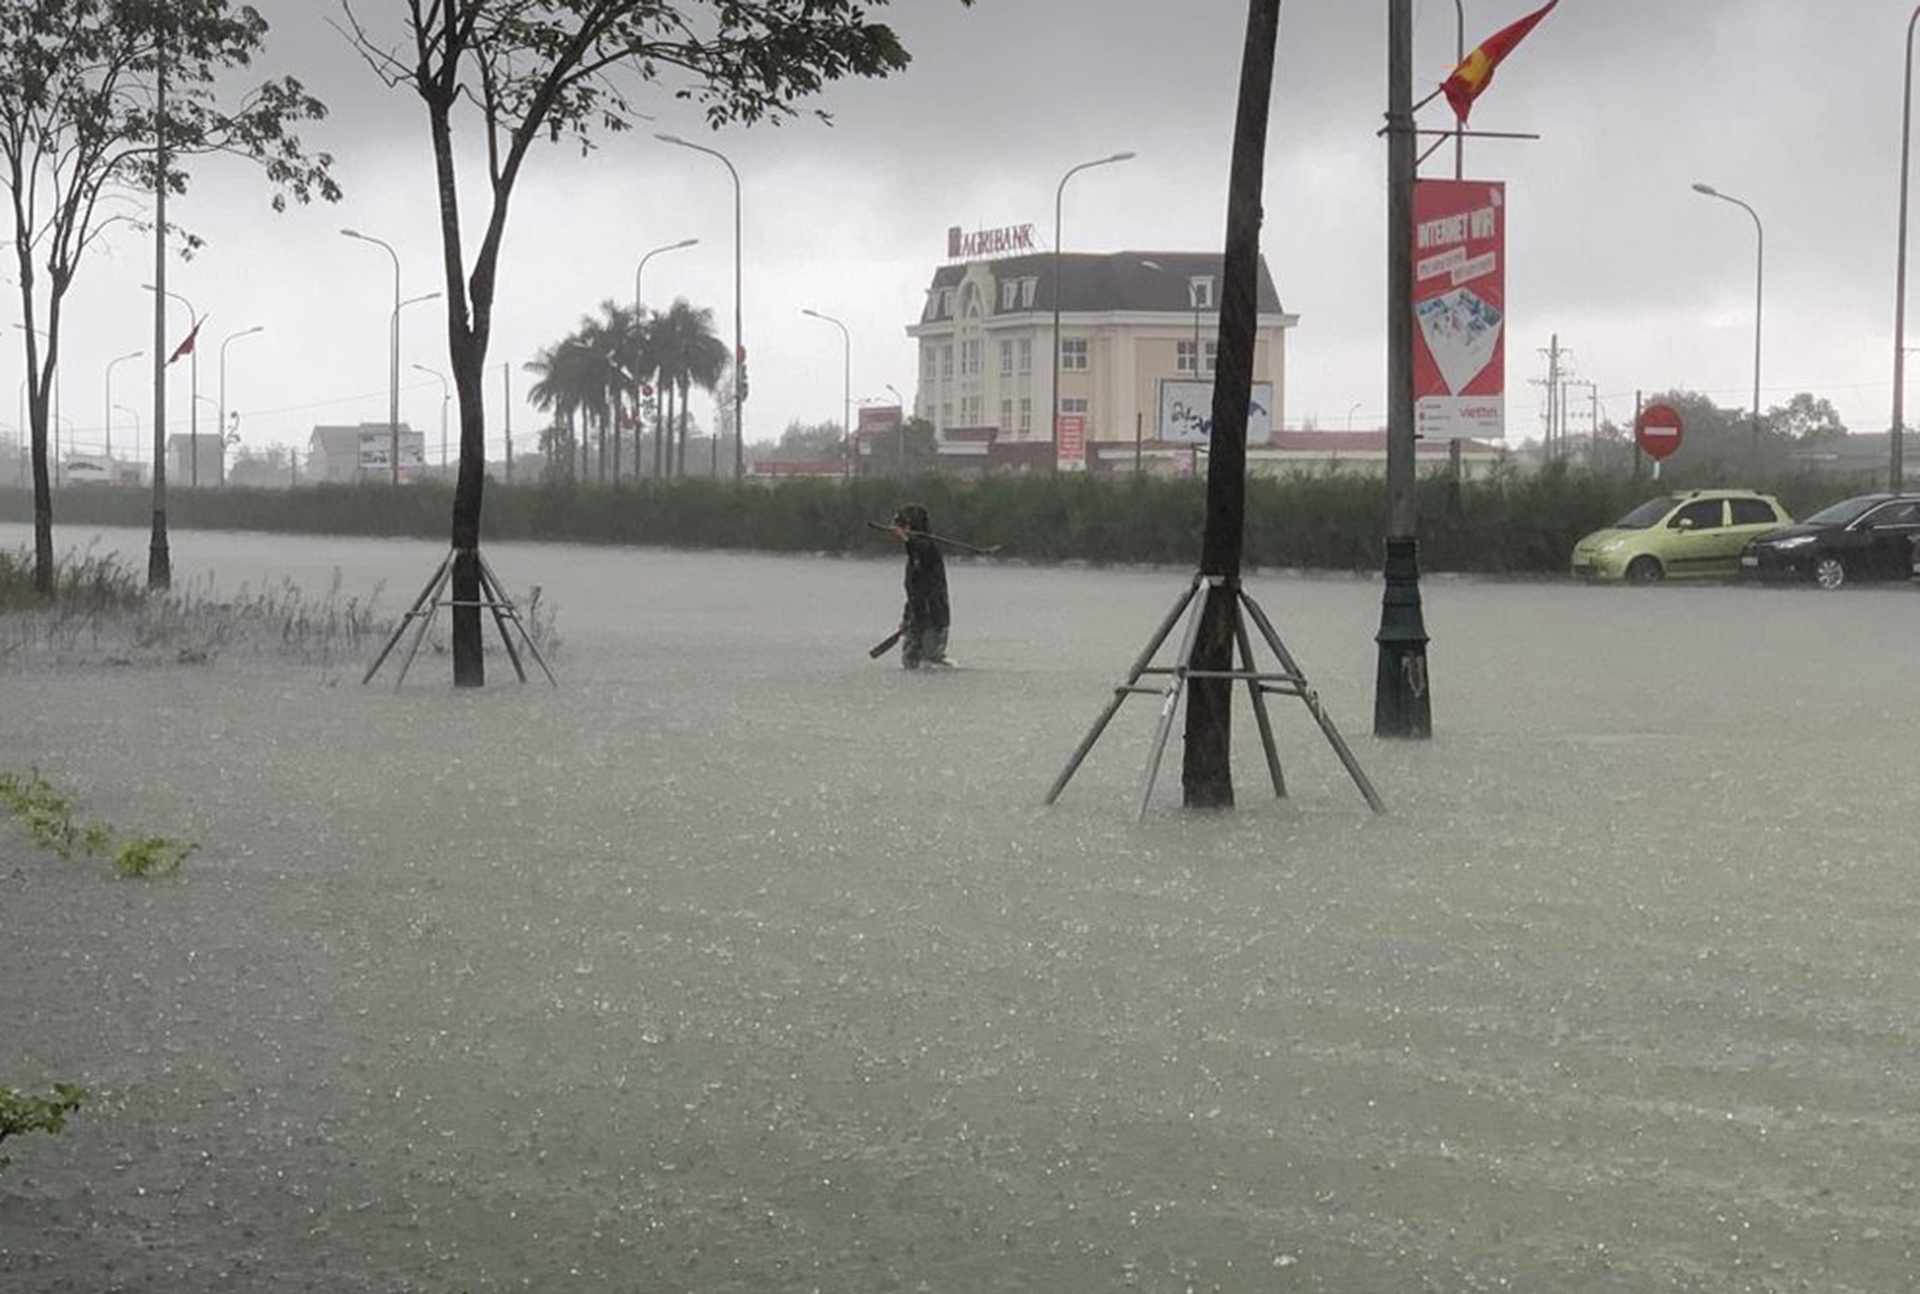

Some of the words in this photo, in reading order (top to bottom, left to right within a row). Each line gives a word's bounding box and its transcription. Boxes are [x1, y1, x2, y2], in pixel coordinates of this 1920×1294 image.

[961, 223, 1034, 254] AGRIBANK
[1418, 212, 1468, 249] INTERNET
[1459, 407, 1498, 419] viettel
